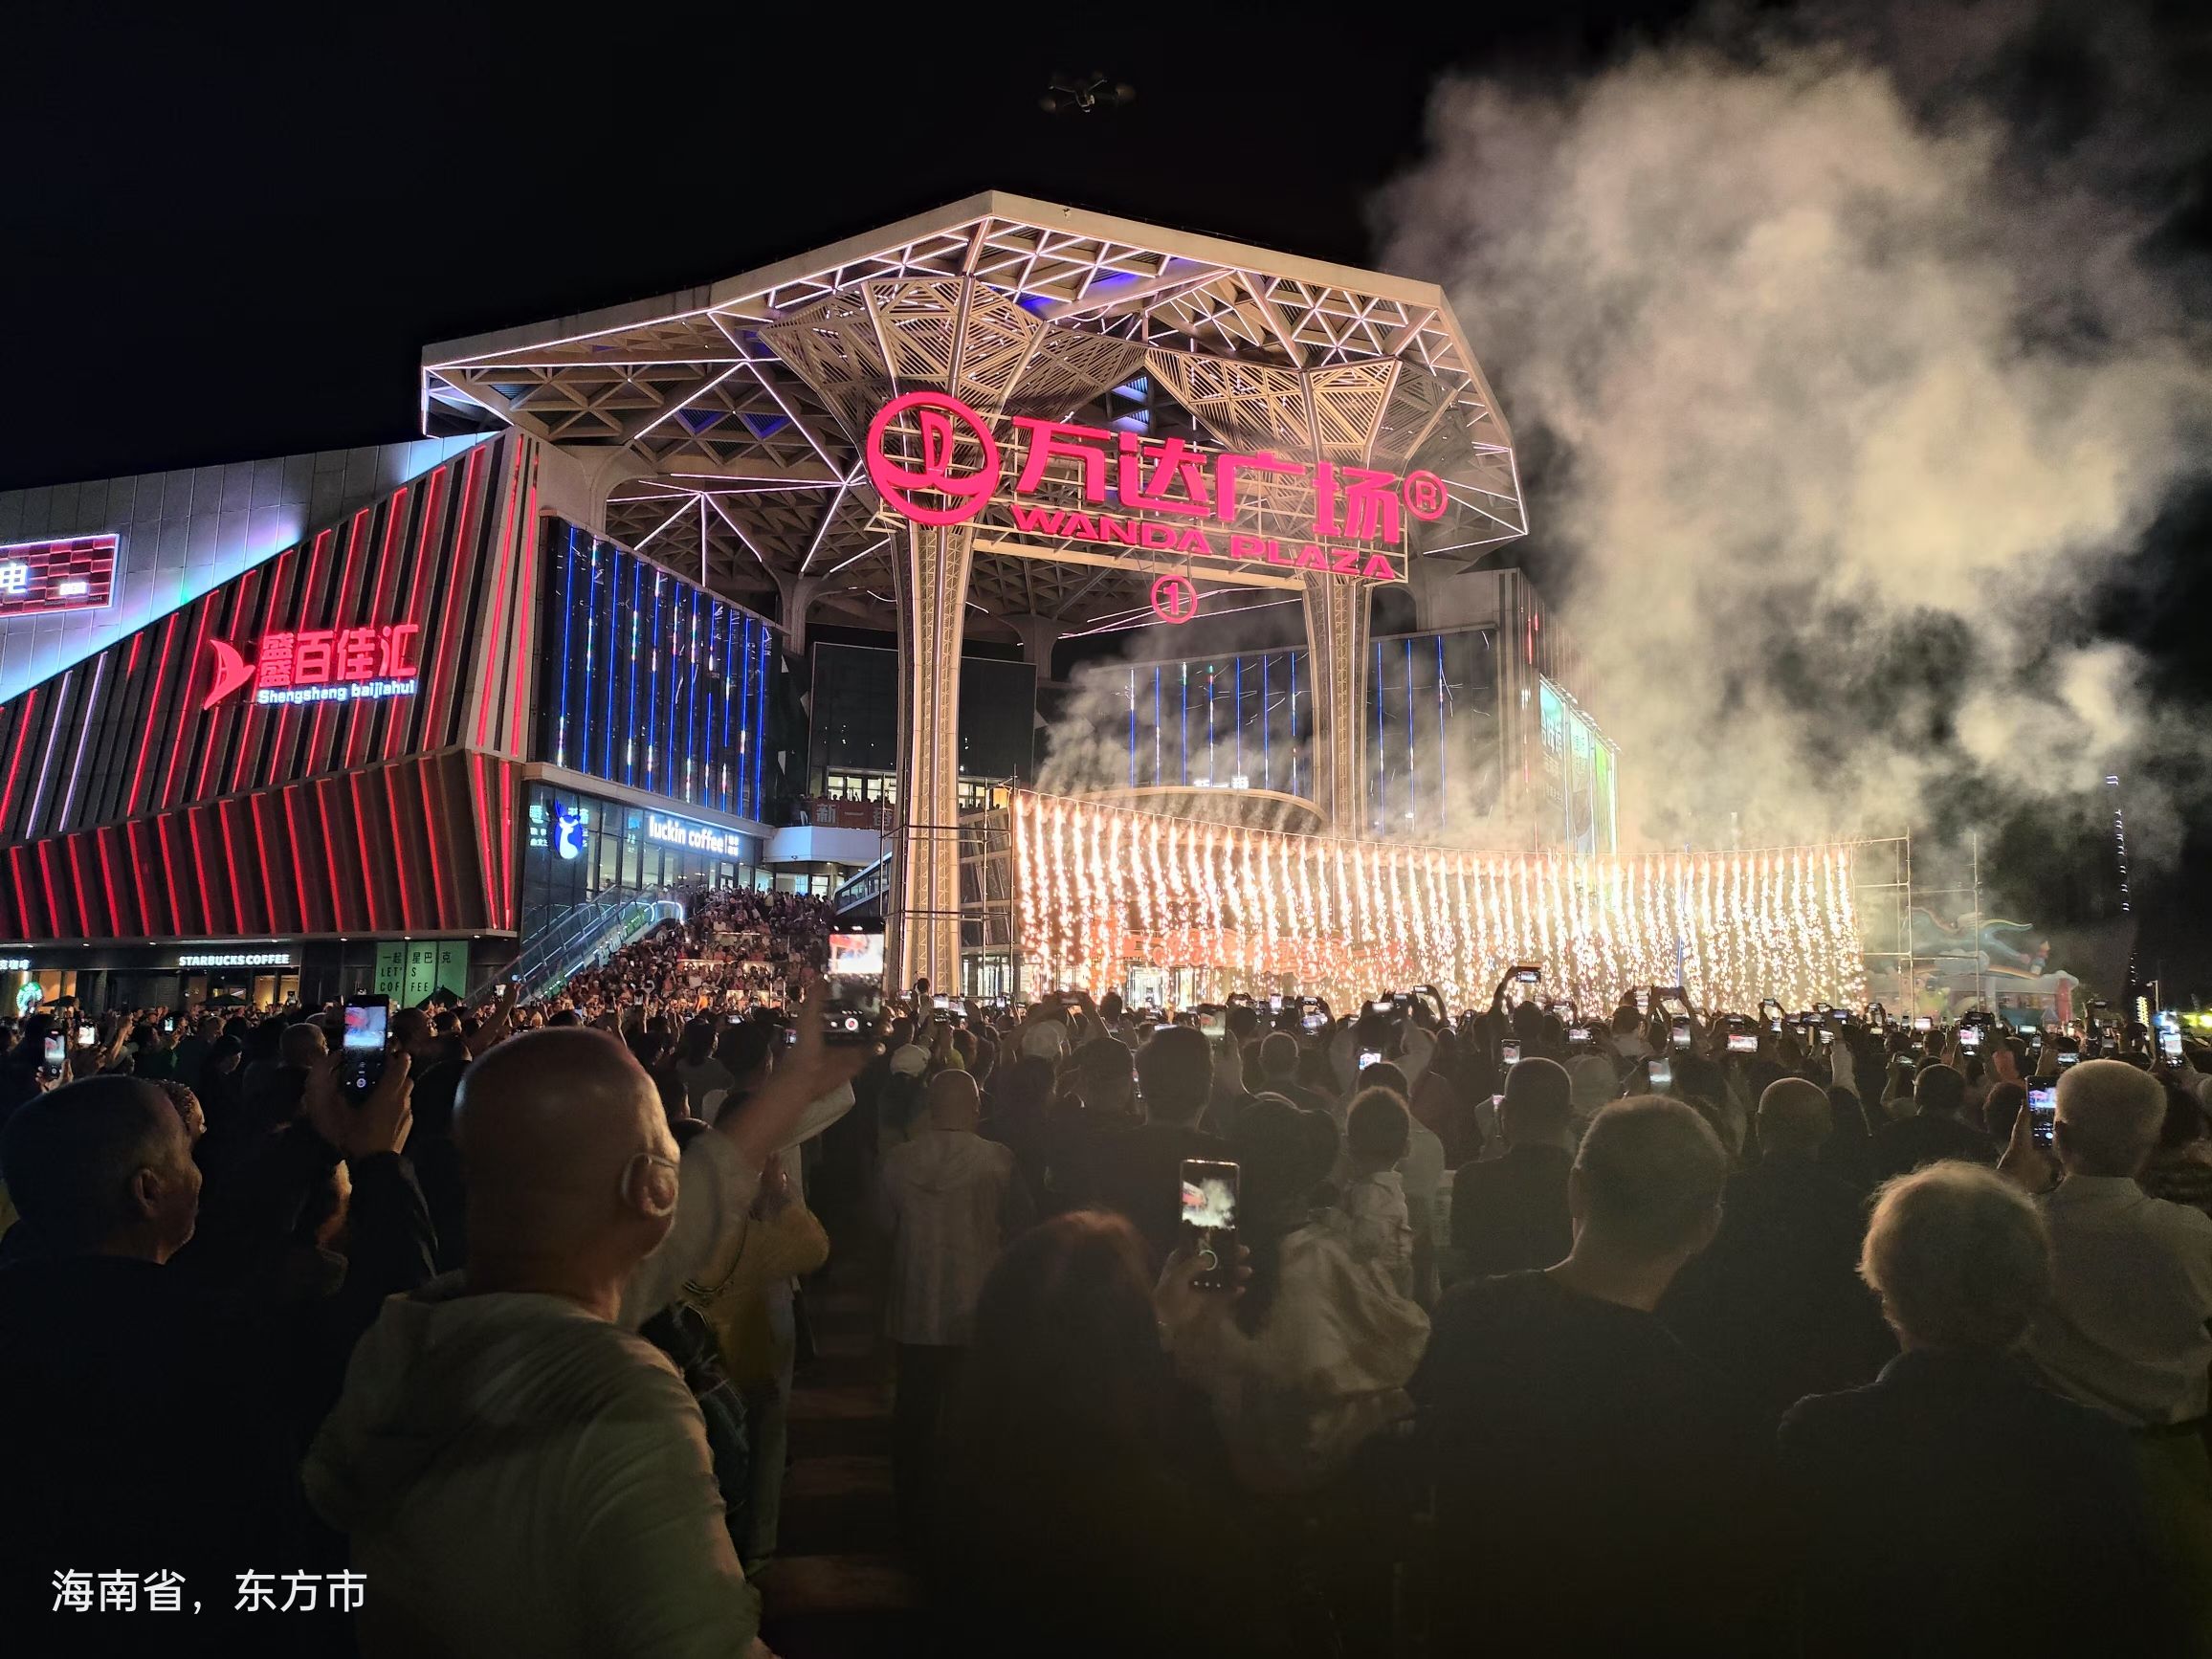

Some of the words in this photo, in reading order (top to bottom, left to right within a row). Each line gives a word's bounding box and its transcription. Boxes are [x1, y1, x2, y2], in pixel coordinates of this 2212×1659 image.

[1012, 415, 1401, 544] 万达广场
[1008, 504, 1213, 556] WANDA
[1230, 535, 1396, 580] PLAZA
[257, 685, 348, 704] Shengsheng
[351, 679, 415, 698] baijiahui
[650, 815, 686, 845] luckin
[688, 828, 724, 853] coffee
[179, 955, 246, 966] STARBUCKS
[246, 954, 290, 964] COFFEE
